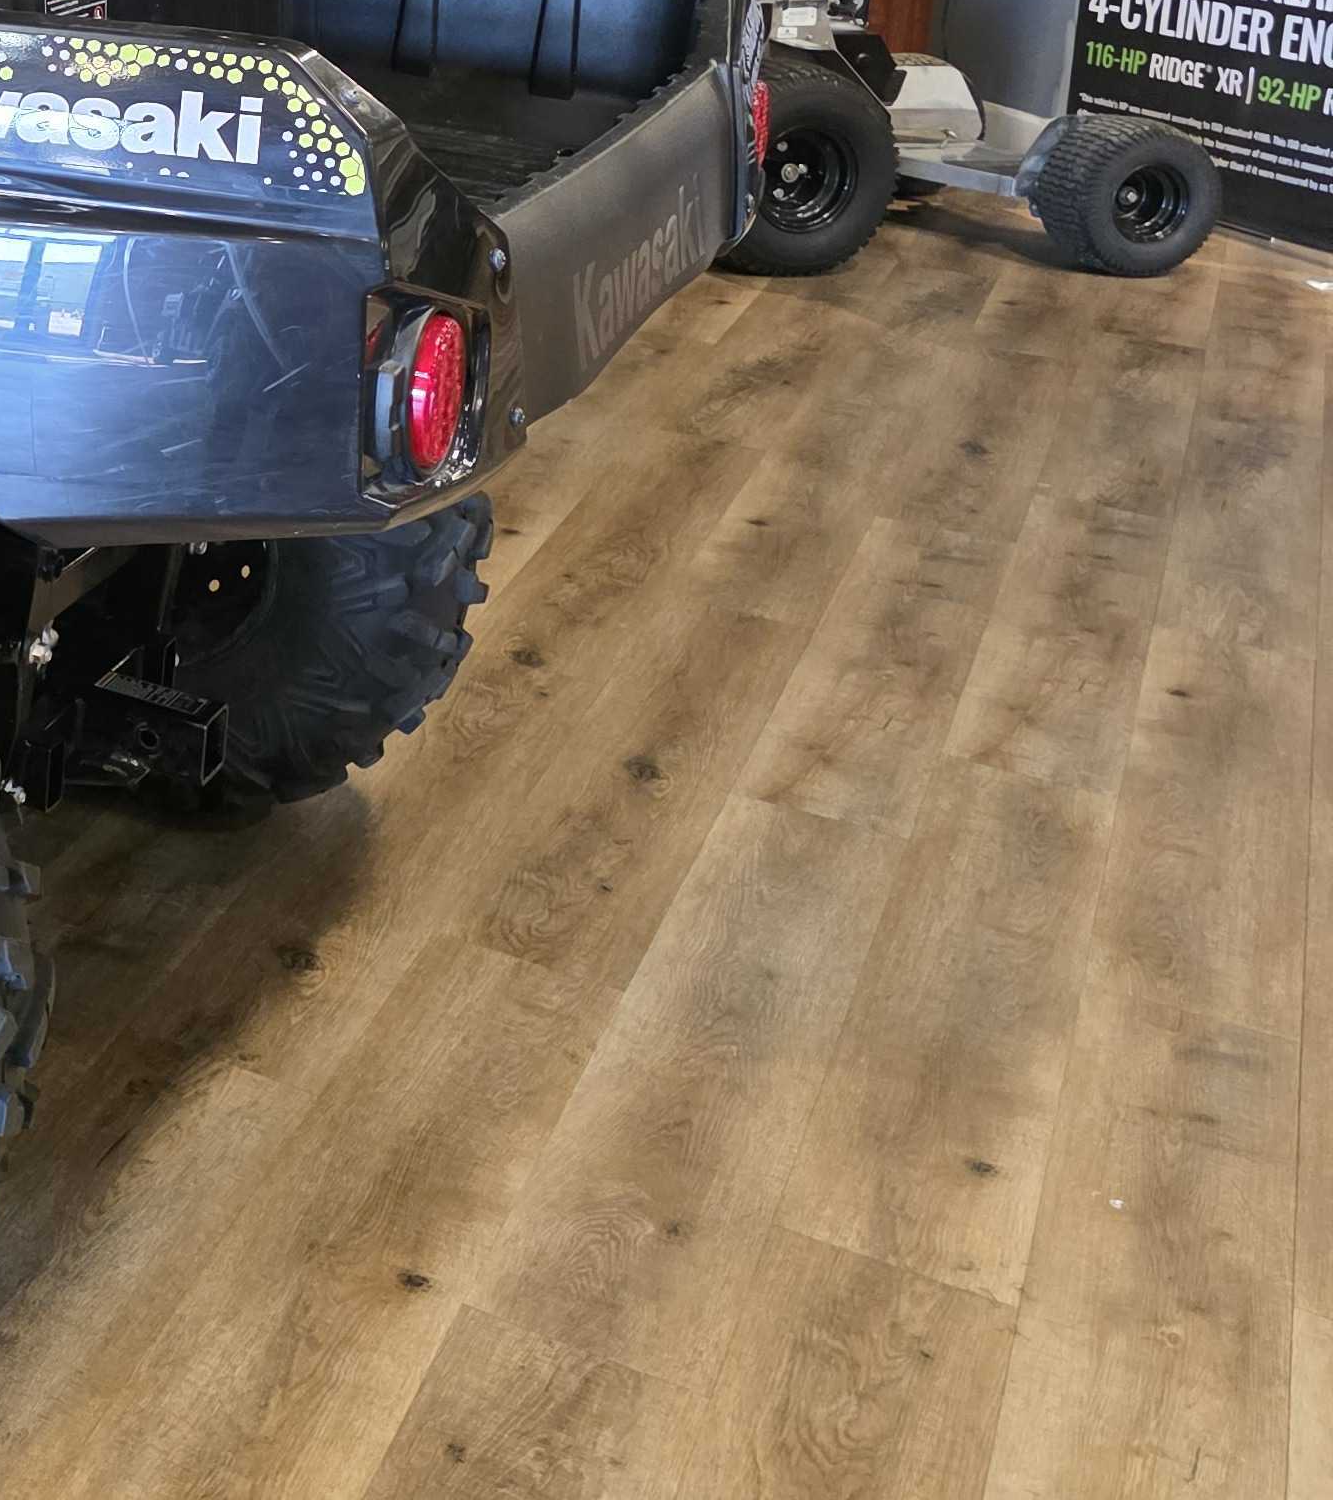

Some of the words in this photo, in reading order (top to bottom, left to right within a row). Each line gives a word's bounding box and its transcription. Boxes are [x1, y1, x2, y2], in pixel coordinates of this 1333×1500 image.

[1085, 40, 1148, 76] 116-HP
[1214, 66, 1244, 97] XR
[1257, 75, 1322, 111] 92-HP
[572, 172, 707, 374] Kawasaki
